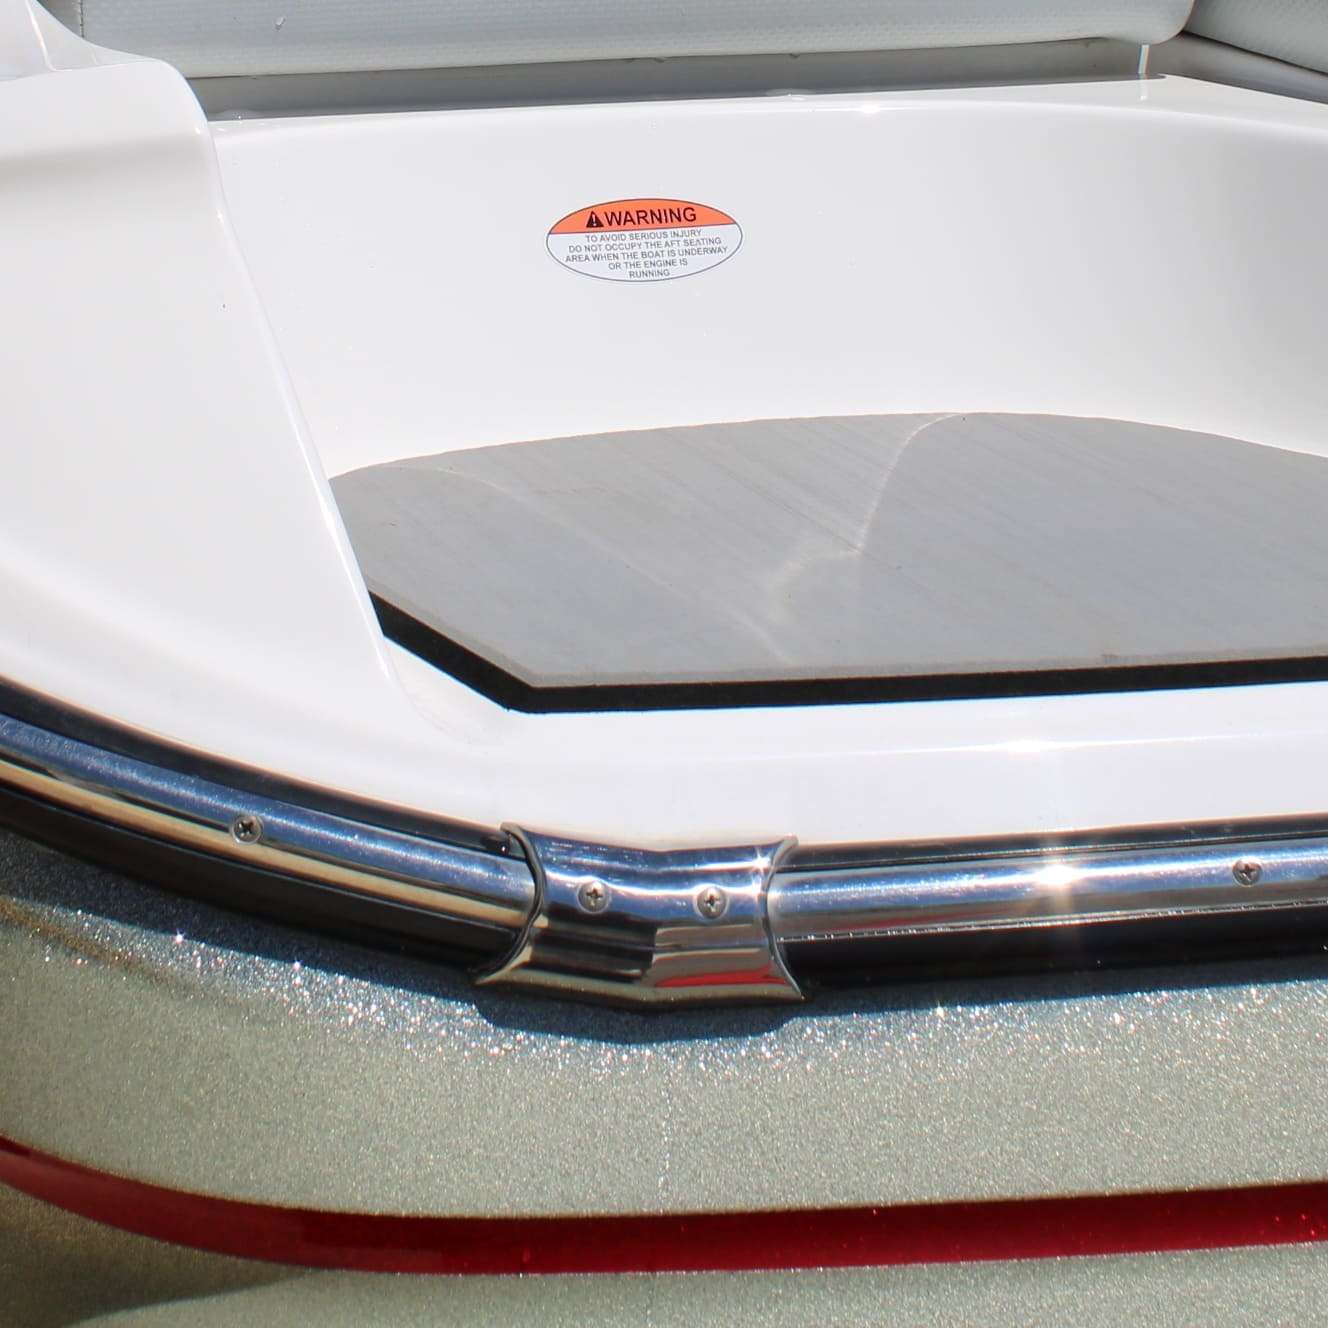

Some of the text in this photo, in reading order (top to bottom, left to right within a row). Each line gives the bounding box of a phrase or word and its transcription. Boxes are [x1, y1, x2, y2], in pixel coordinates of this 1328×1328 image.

[604, 206, 697, 226] WARNING
[585, 228, 702, 243] TO AVOID SERIOUS INJURY
[568, 236, 722, 253] DO NOT OCCUPY THE AFT SEATING
[565, 246, 728, 263] AREA WHEN THE BOAT IS UNDERWAY
[608, 257, 688, 270] OR THE ENGINE IS
[628, 268, 671, 279] RUNNING
